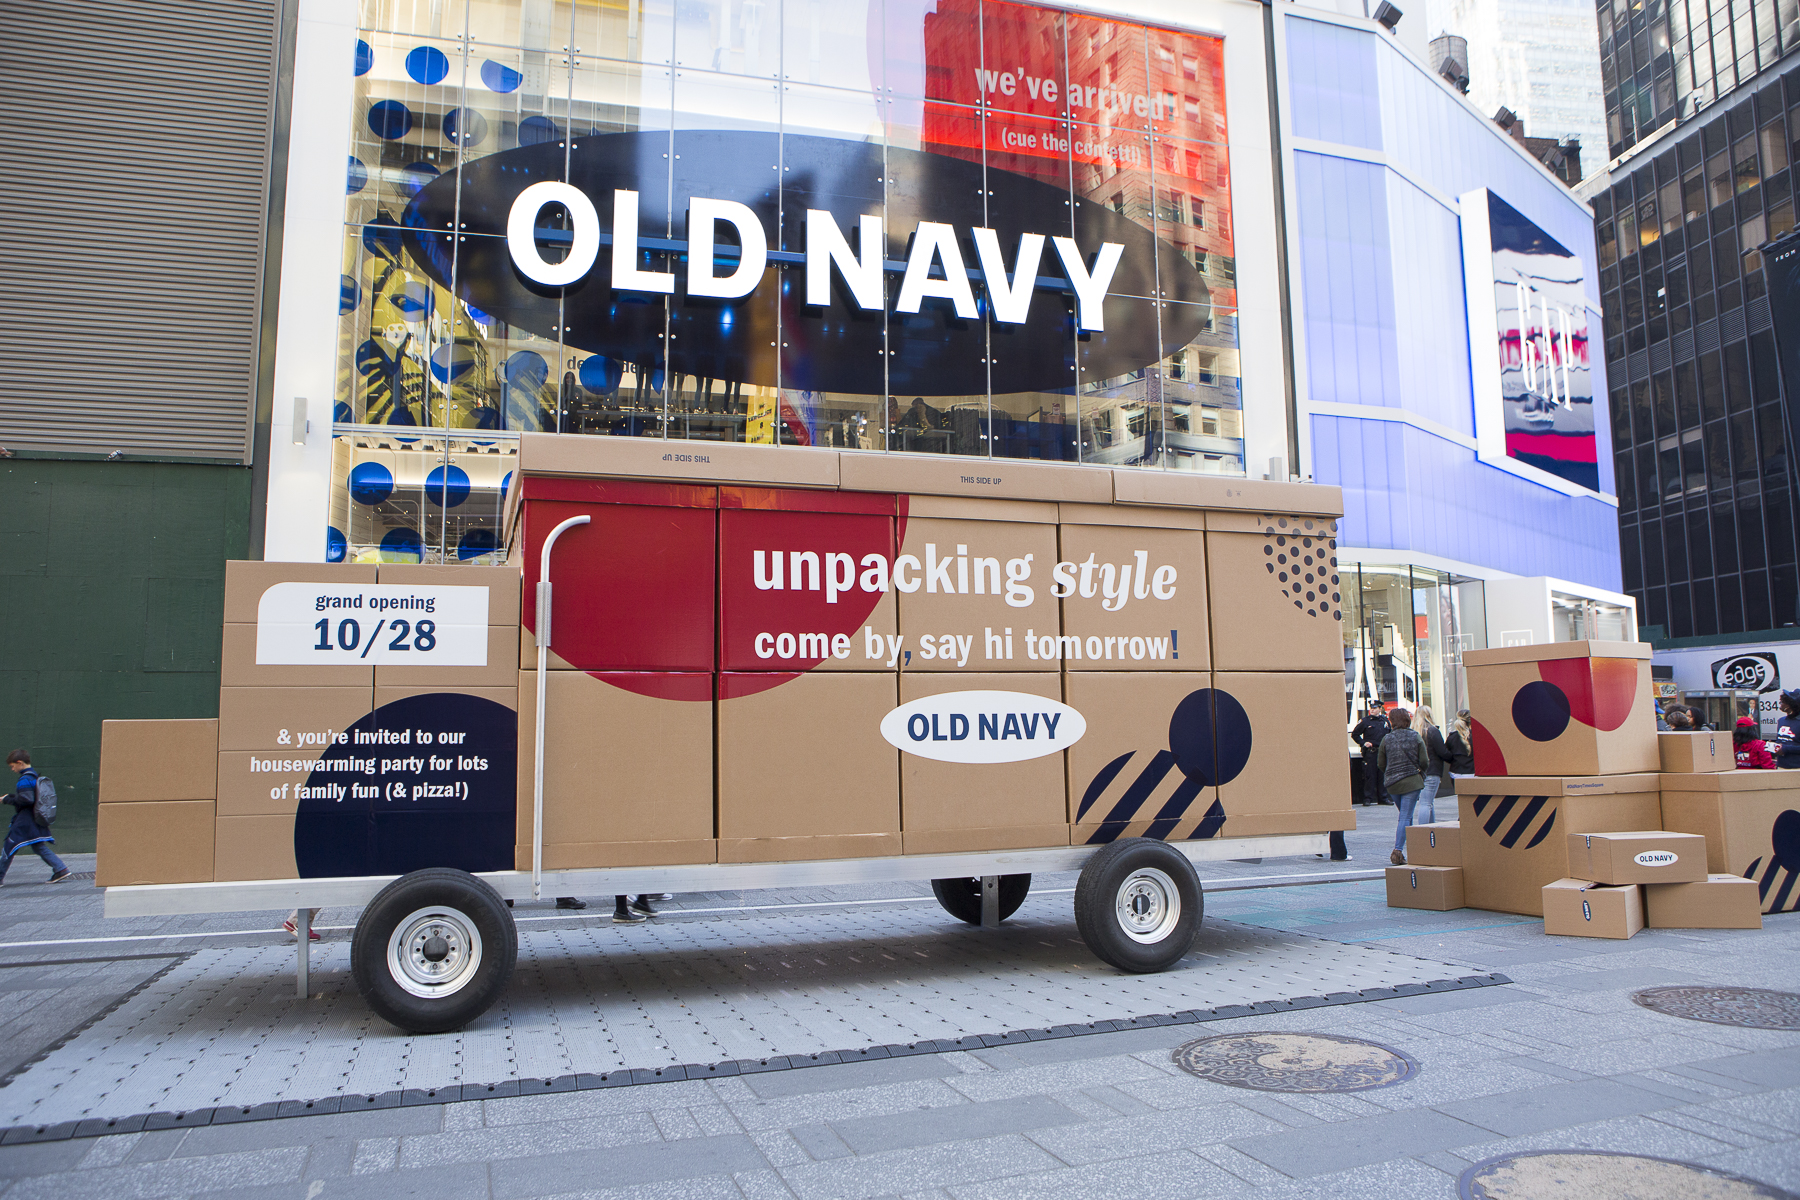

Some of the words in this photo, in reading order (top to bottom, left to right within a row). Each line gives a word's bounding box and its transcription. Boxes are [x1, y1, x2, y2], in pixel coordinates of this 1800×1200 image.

[974, 67, 1058, 102] we've
[1068, 83, 1175, 122] arrived!
[1001, 127, 1037, 148] (cue
[1041, 133, 1068, 152] the
[1074, 141, 1142, 166] confetti)
[506, 181, 767, 300] OLD
[806, 209, 1125, 333] NAVY
[1516, 280, 1574, 412] GAP
[662, 453, 673, 461] UP
[674, 454, 692, 462] SIDE
[694, 455, 711, 463] THIS
[960, 475, 975, 483] THIS
[976, 476, 991, 484] SIDE
[753, 543, 1035, 608] unpacking
[1049, 550, 1178, 612] style
[315, 594, 363, 611] grand
[369, 595, 435, 613] opening
[314, 618, 437, 659] 10/28
[754, 629, 851, 660] come
[863, 626, 912, 668] by,
[919, 632, 973, 667] say
[984, 627, 1013, 660] hi
[1025, 628, 1179, 660] tomorrow!
[1724, 663, 1766, 685] edge
[1759, 700, 1781, 711] 334
[907, 713, 970, 741] OLD
[978, 712, 1062, 741] NAVY
[276, 728, 292, 745] &
[296, 728, 349, 748] you're
[354, 728, 411, 745] invited
[416, 730, 433, 745] to
[438, 732, 466, 745] our
[250, 756, 377, 774] housewarming
[381, 756, 424, 774] party
[429, 755, 453, 771] for
[457, 755, 489, 771] lots
[270, 783, 289, 800] of
[293, 783, 347, 802] family
[351, 782, 380, 799] fun
[385, 782, 407, 801] (&
[412, 782, 469, 801] pizza!)
[1654, 854, 1673, 862] NAVY
